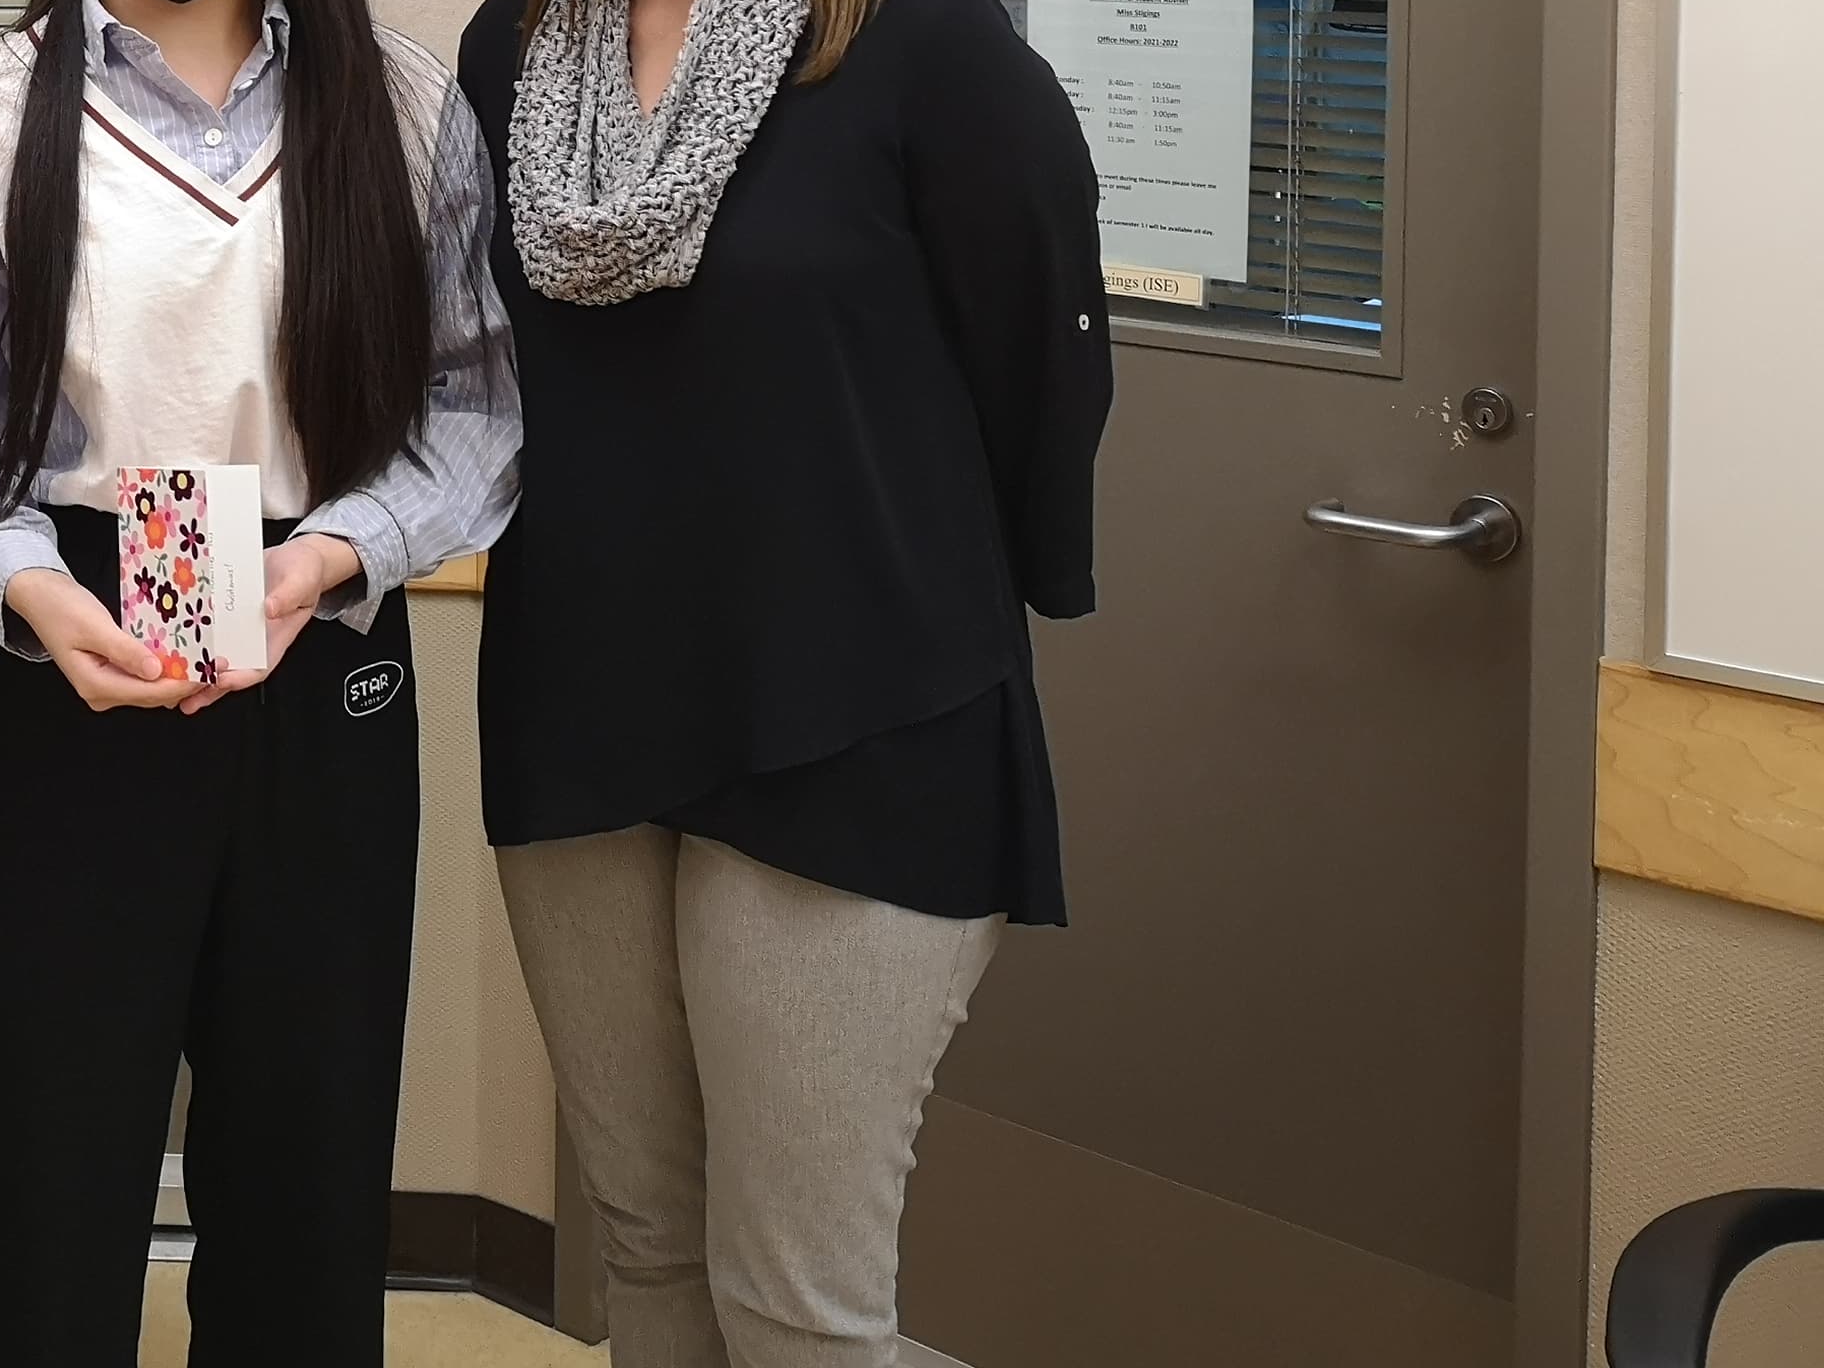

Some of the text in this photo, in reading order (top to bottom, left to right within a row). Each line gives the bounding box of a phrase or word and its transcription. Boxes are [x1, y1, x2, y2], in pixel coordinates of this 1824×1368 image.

[1117, 9, 1161, 19] Miss Stigings
[1097, 36, 1179, 47] Office Hours: 2021-2022
[1152, 81, 1182, 90] 10:50am
[1152, 95, 1181, 104] 11:15am
[1153, 110, 1179, 119] 3:00pm
[1154, 124, 1183, 133] 11:15am
[1143, 276, 1179, 295] (ISE)
[350, 673, 389, 701] STAR
